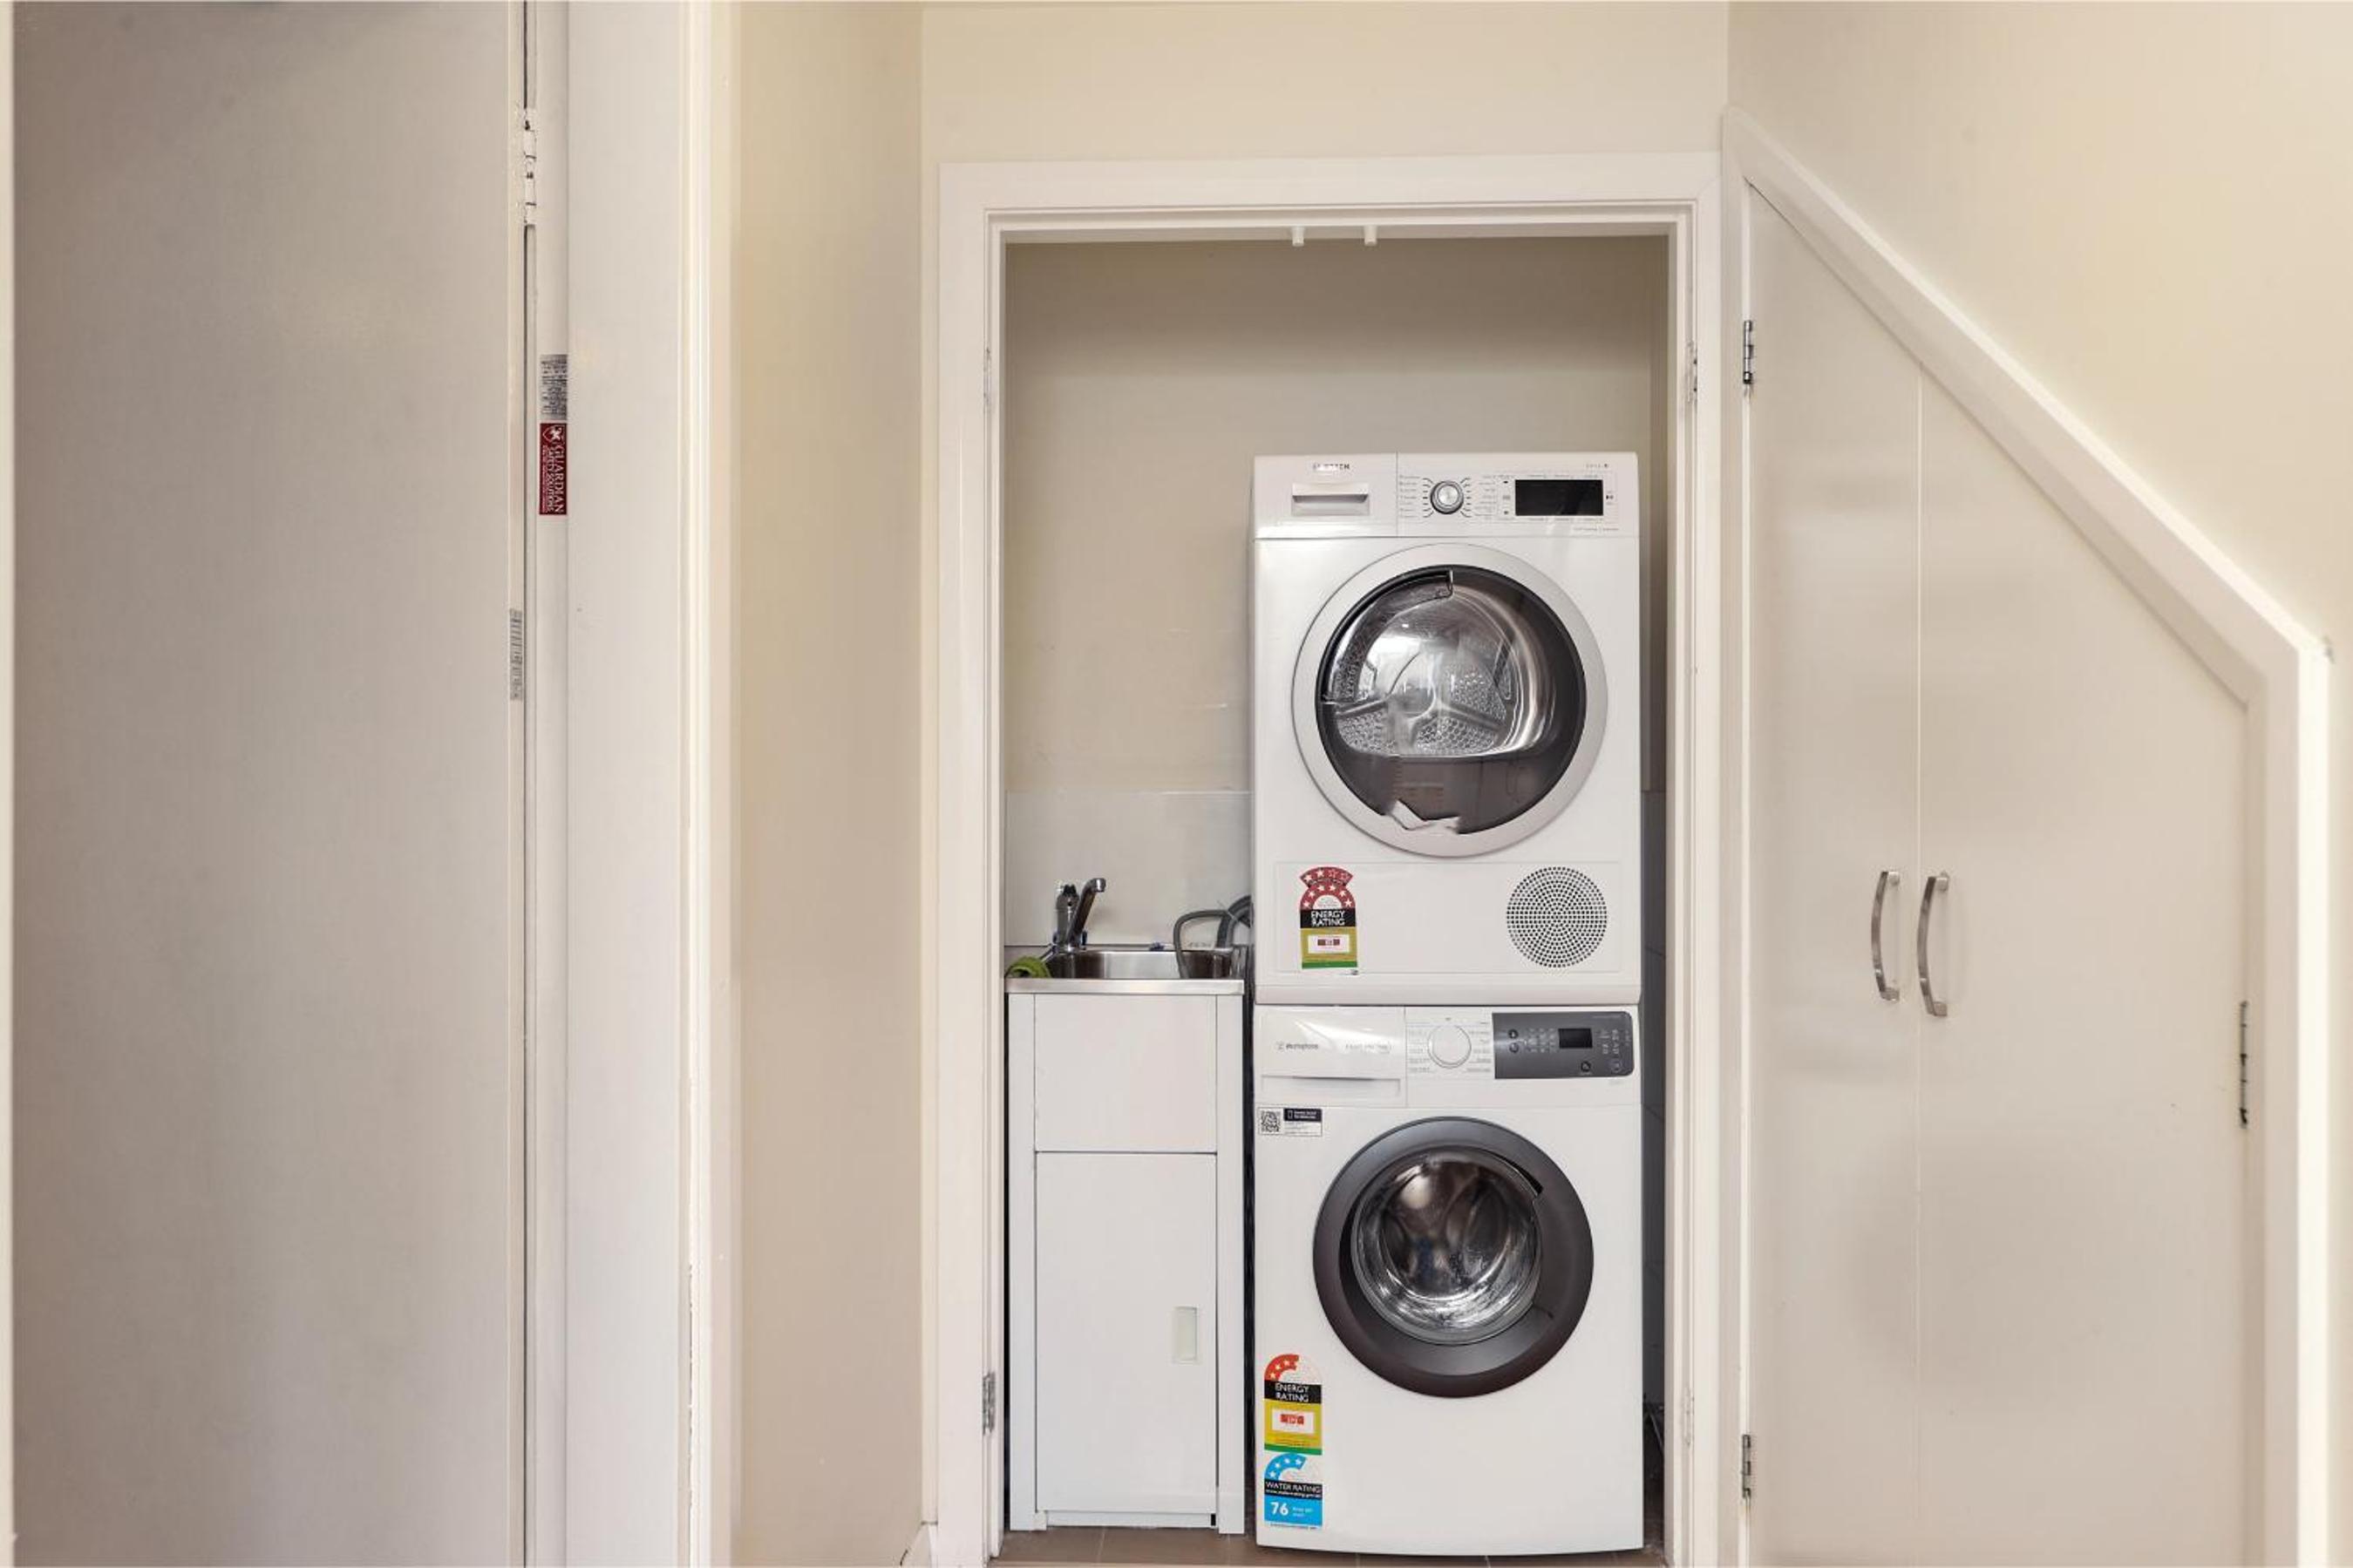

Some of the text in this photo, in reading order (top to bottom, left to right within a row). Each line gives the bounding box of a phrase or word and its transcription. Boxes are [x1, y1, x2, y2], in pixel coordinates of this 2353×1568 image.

[554, 445, 565, 512] GUARDIAN
[1310, 910, 1345, 919] ENERGY
[1275, 1382, 1309, 1393] ENERGY
[1275, 1392, 1309, 1402] RATING
[1265, 1482, 1322, 1493] WATER RATING
[1270, 1501, 1289, 1516] 76
